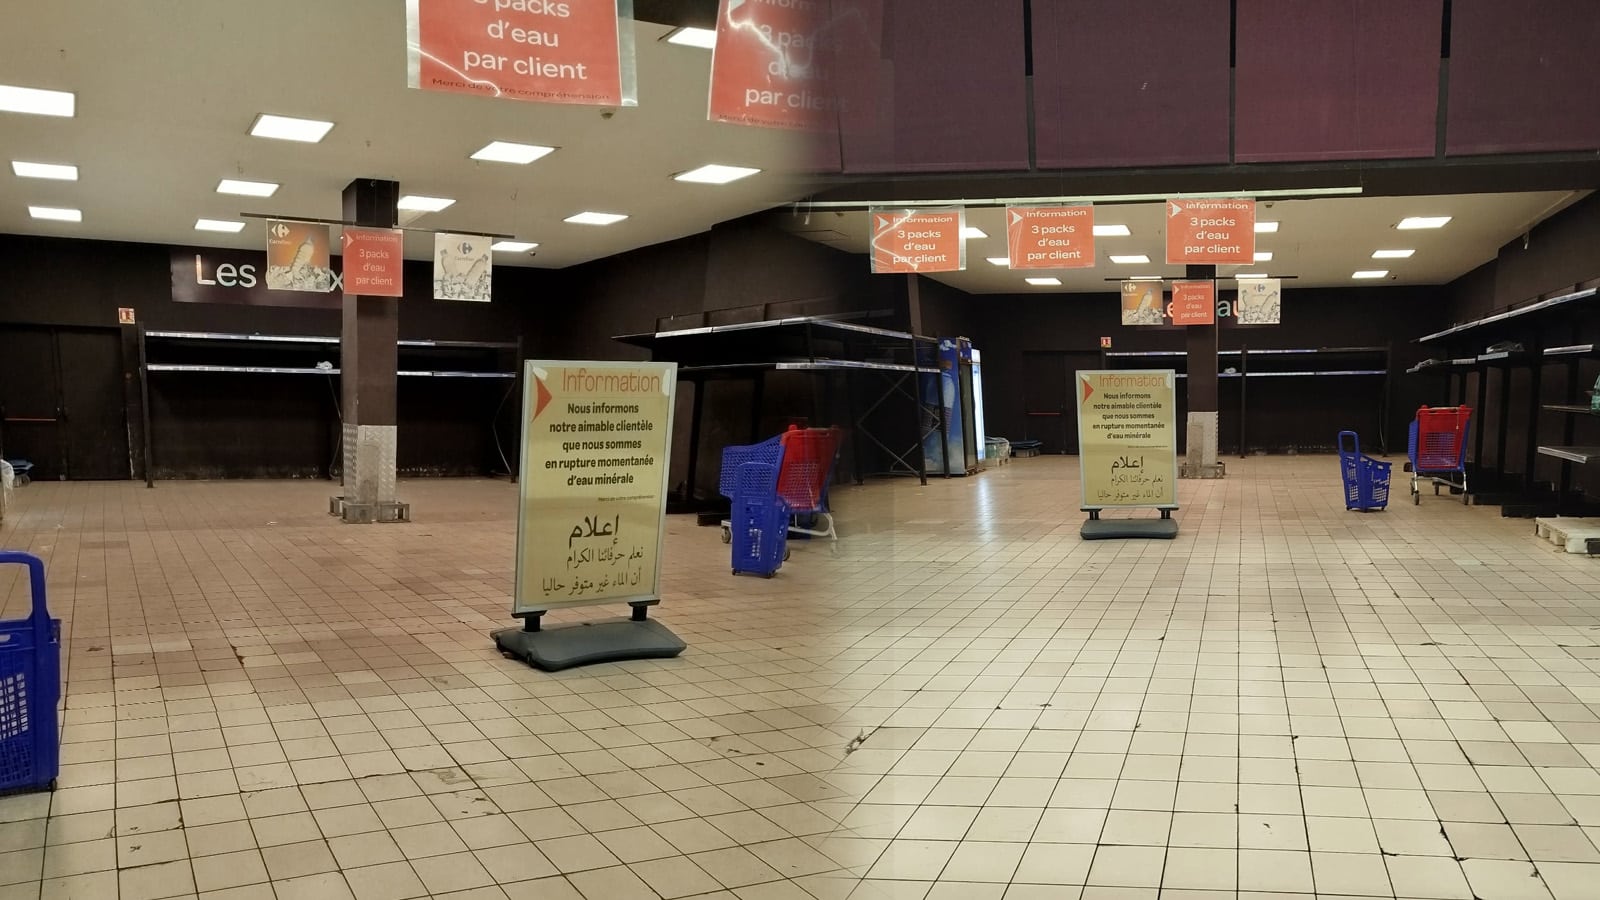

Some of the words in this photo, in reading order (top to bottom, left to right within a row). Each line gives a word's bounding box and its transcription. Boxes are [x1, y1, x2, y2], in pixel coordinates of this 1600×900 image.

[495, 0, 570, 18] packs
[463, 50, 508, 71] par
[513, 57, 588, 80] client
[432, 78, 467, 88] Merci
[745, 88, 784, 107] par
[1186, 201, 1249, 210] Information
[1026, 209, 1087, 218] Information
[1190, 217, 1198, 226] 3
[1200, 217, 1236, 228] packs
[897, 230, 905, 239] 3
[907, 230, 942, 240] packs
[1031, 225, 1039, 234] 3
[1041, 224, 1076, 235] packs
[359, 248, 365, 258] 3
[365, 249, 390, 260] packs
[1027, 252, 1047, 262] par
[1048, 250, 1081, 260] client
[1184, 245, 1205, 255] par
[1206, 244, 1241, 254] client
[914, 254, 947, 263] client
[195, 254, 257, 288] Les
[355, 277, 370, 287] par
[370, 276, 393, 286] client
[562, 368, 660, 393] Information
[1099, 375, 1165, 388] Information
[1119, 392, 1151, 400] informons
[567, 403, 591, 414] Nous
[592, 402, 640, 414] informons
[1110, 402, 1136, 410] aimable
[1135, 401, 1162, 410] clientèle
[1102, 414, 1114, 422] que
[549, 422, 577, 433] notre
[577, 420, 615, 432] aimable
[615, 419, 653, 432] clientèle
[1100, 423, 1125, 431] rupture
[1125, 421, 1165, 430] momentanée
[1124, 431, 1151, 440] minérale
[562, 442, 581, 453] que
[581, 441, 604, 451] nous
[605, 440, 642, 450] sommes
[545, 459, 557, 469] en
[558, 458, 596, 471] rupture
[597, 454, 654, 468] momentanée
[1111, 456, 1144, 474] إعلام
[594, 473, 634, 486] minérale
[568, 513, 620, 550] إعلام
[566, 547, 595, 572] الكرام
[598, 546, 625, 566] حرفائنا
[627, 545, 644, 568] نعلم
[595, 574, 610, 594] غير
[612, 571, 629, 587] الماء
[542, 577, 566, 597] حاليا
[568, 576, 594, 596] متوفر
